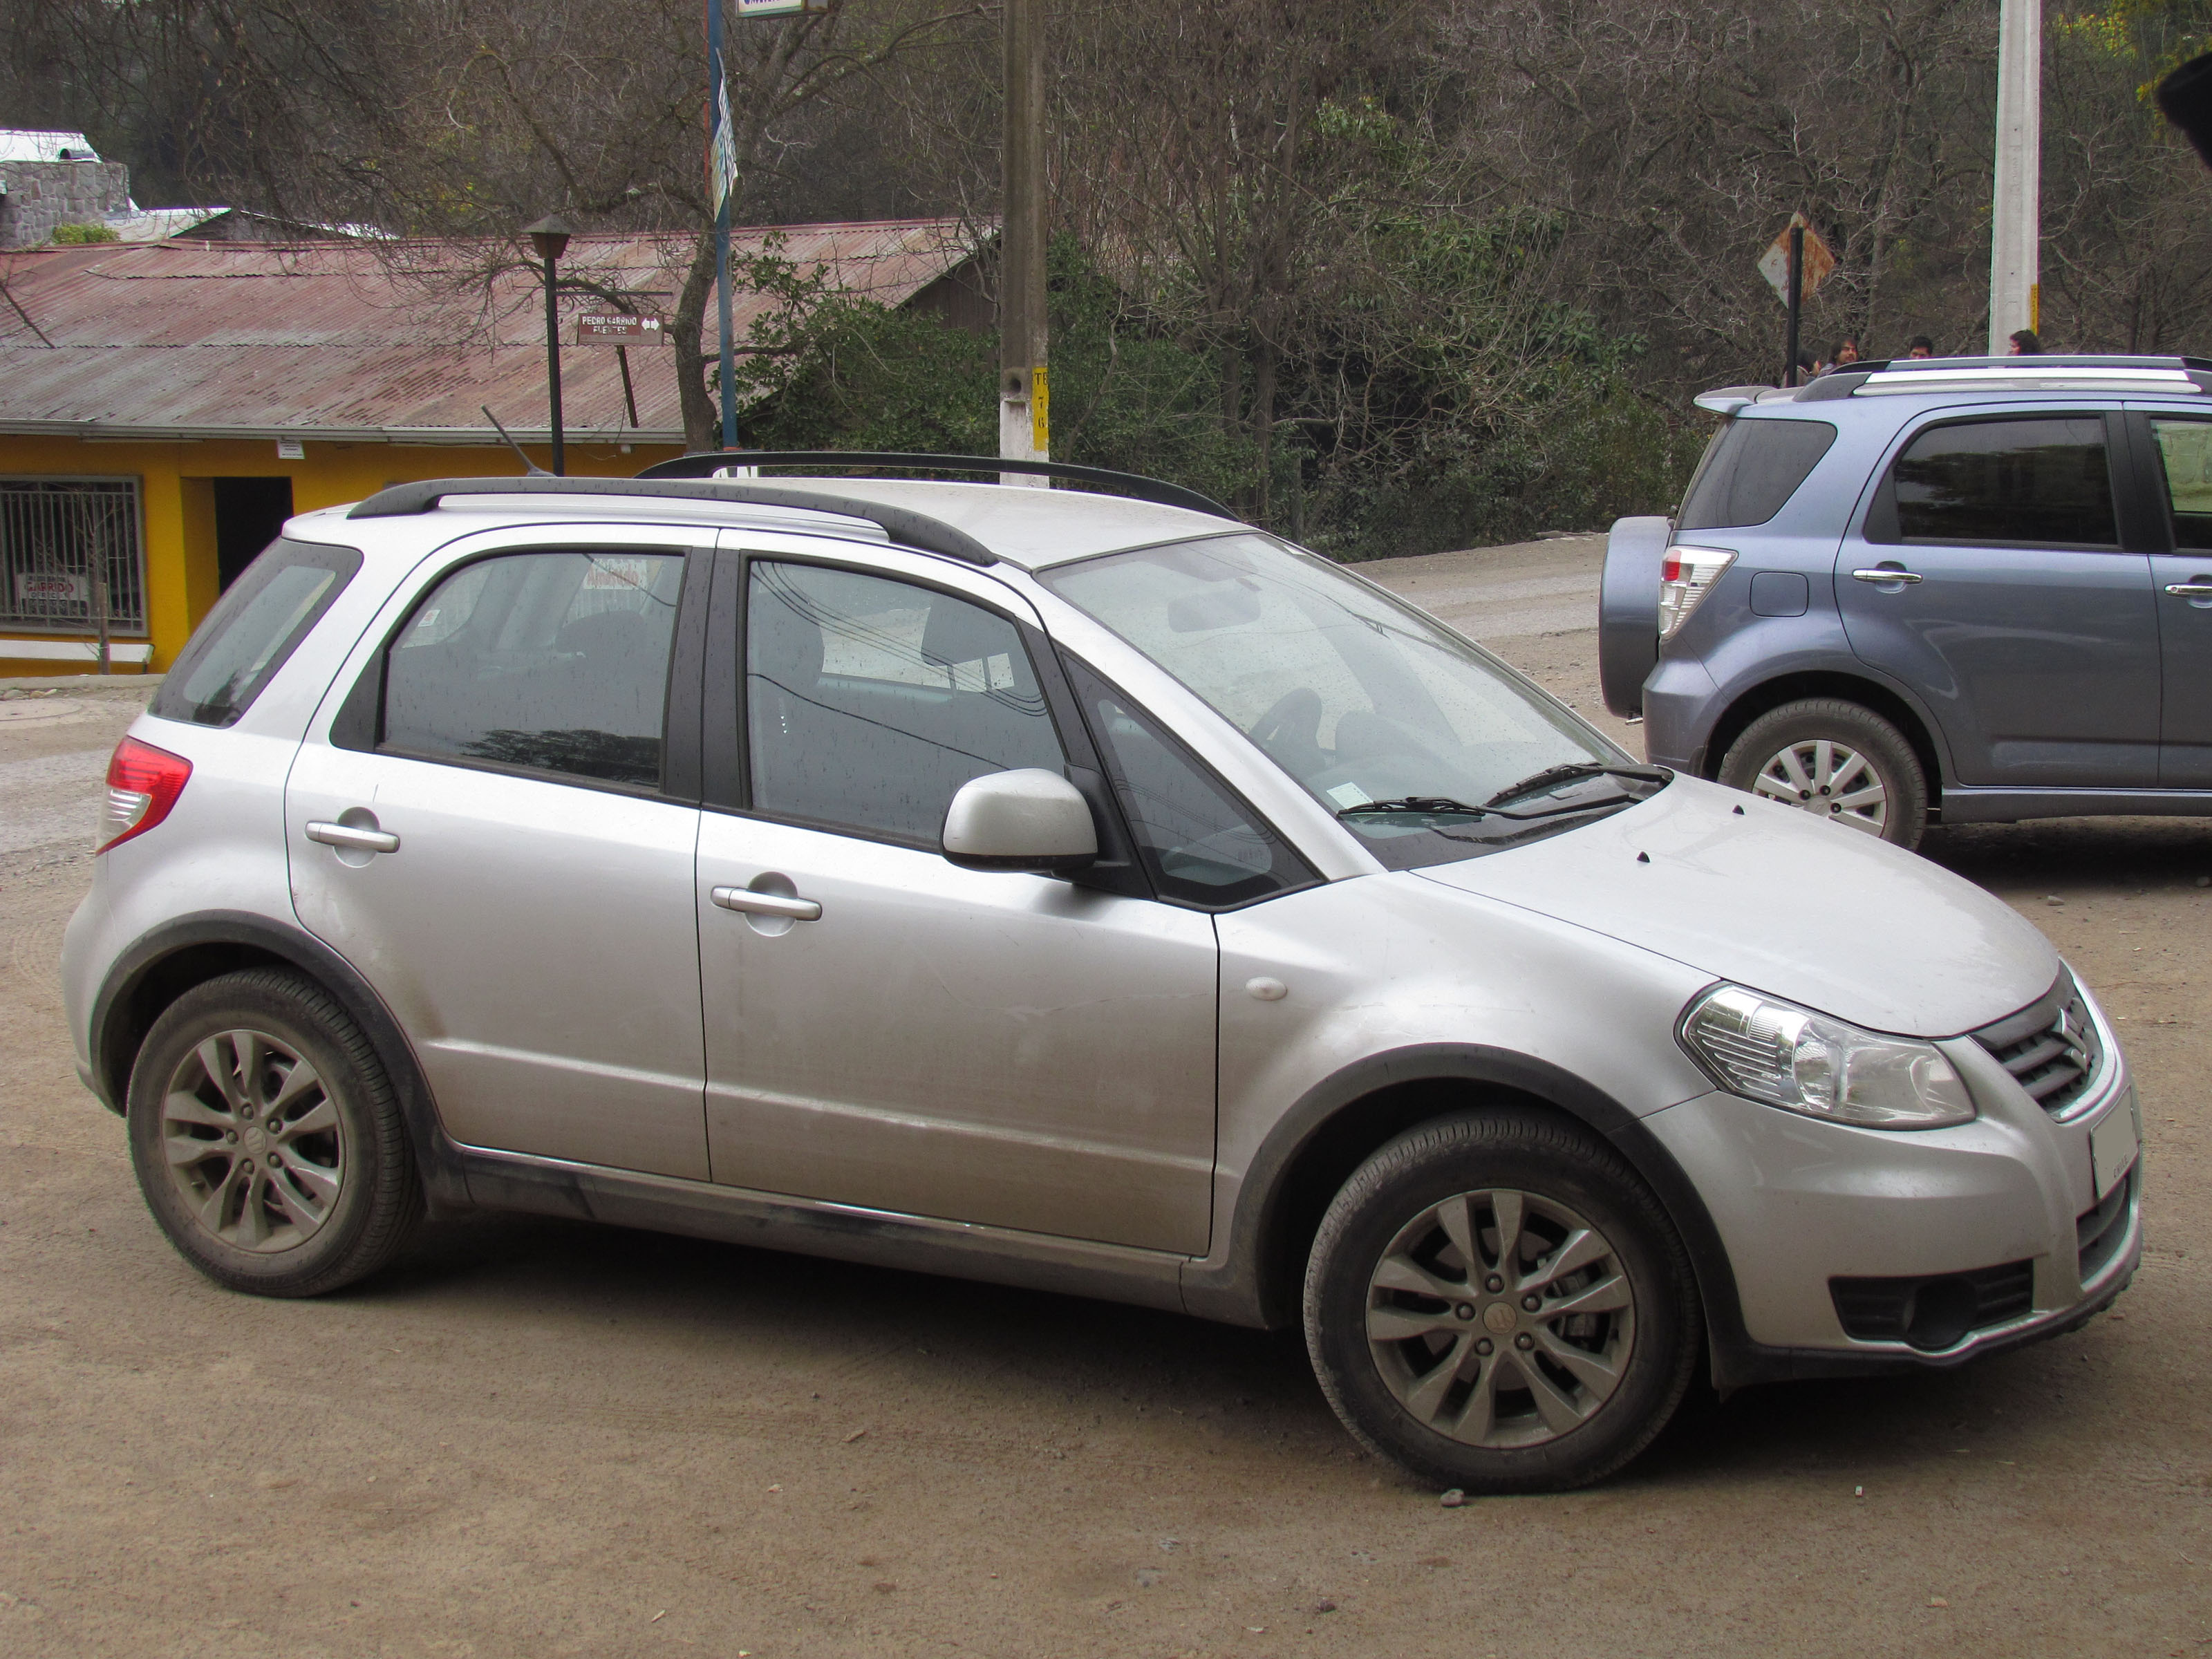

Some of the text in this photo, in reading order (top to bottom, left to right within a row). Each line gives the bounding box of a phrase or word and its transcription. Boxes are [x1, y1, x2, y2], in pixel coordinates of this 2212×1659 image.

[582, 316, 606, 325] PEDRO
[593, 326, 627, 335] FUEES
[25, 581, 74, 592] GARRDO
[2114, 1154, 2128, 1178] CHILE
